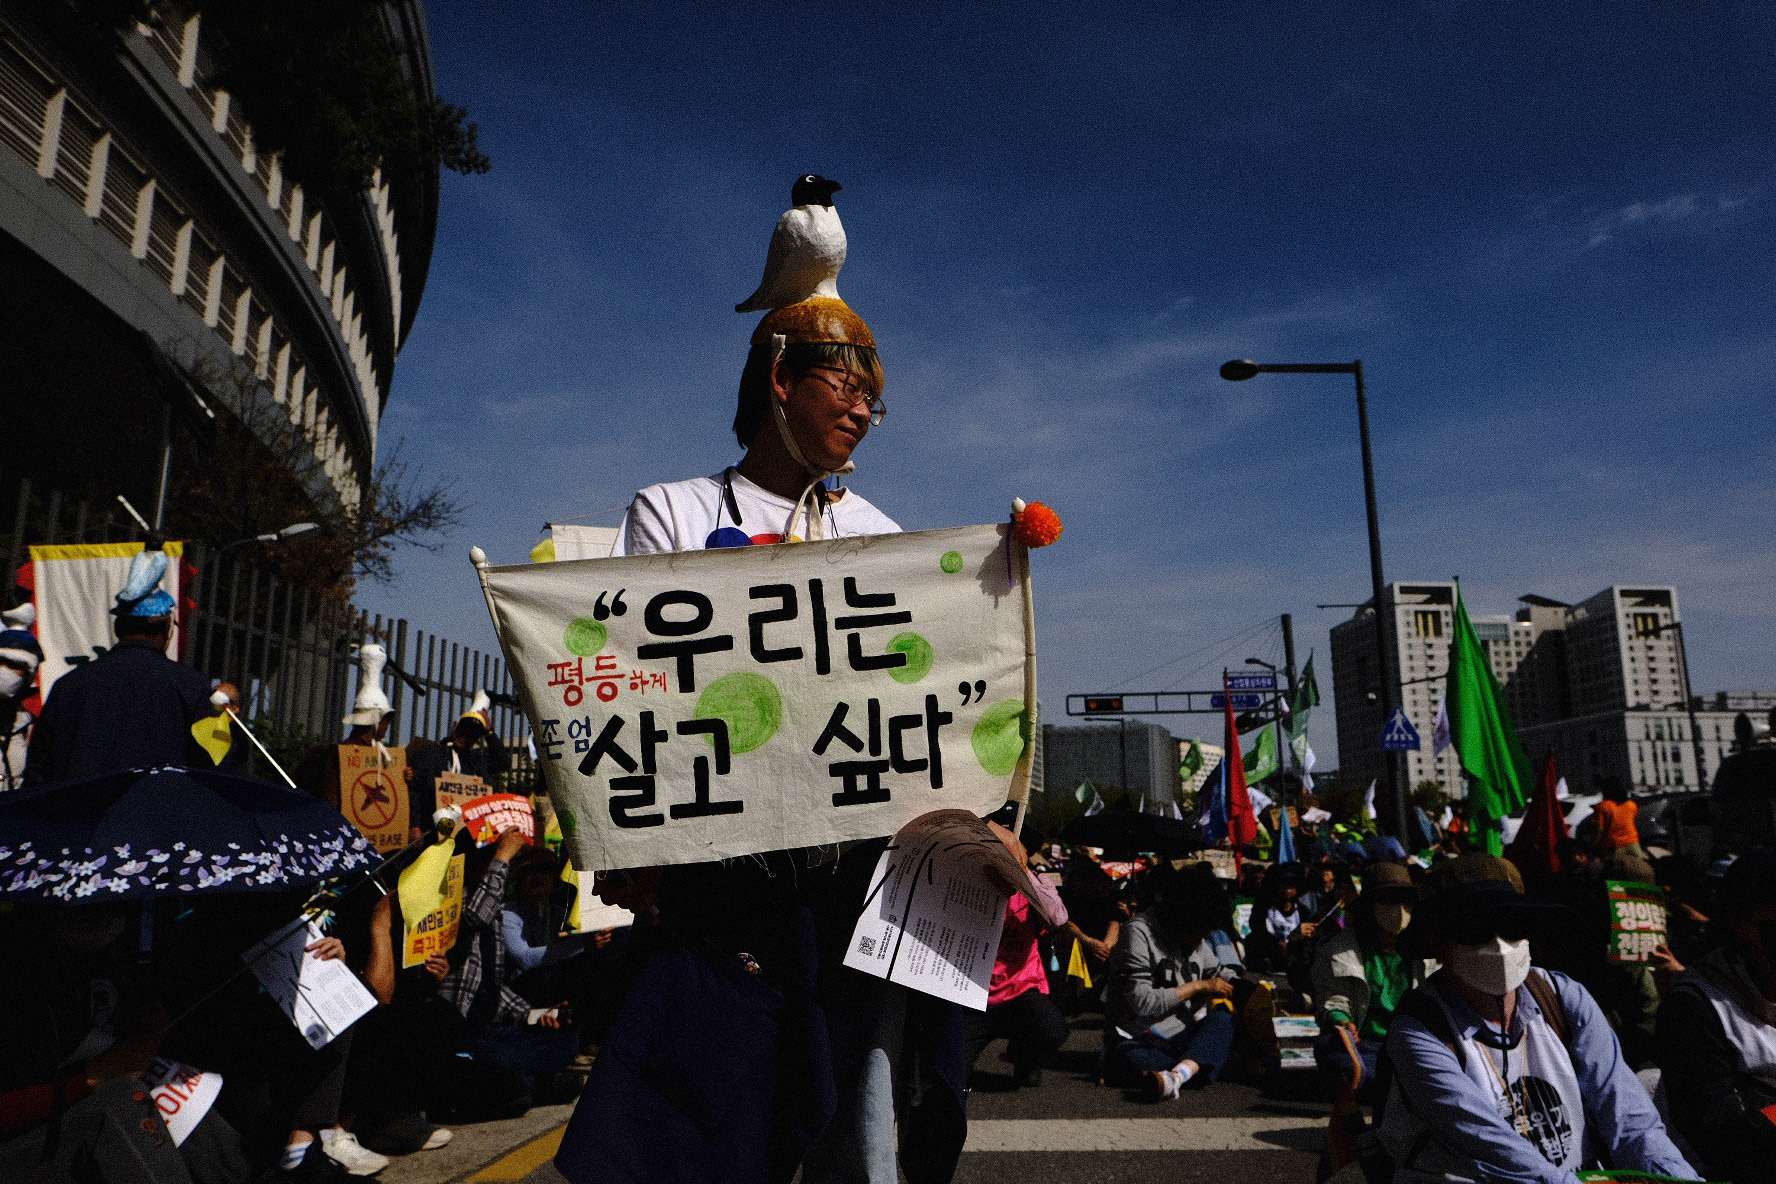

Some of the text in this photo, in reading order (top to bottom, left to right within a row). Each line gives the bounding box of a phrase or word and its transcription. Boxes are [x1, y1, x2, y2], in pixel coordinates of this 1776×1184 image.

[593, 577, 912, 693] “우리는
[546, 656, 667, 707] 평등하게
[541, 715, 592, 761] 존엄
[578, 680, 988, 829] 살고 싶다”
